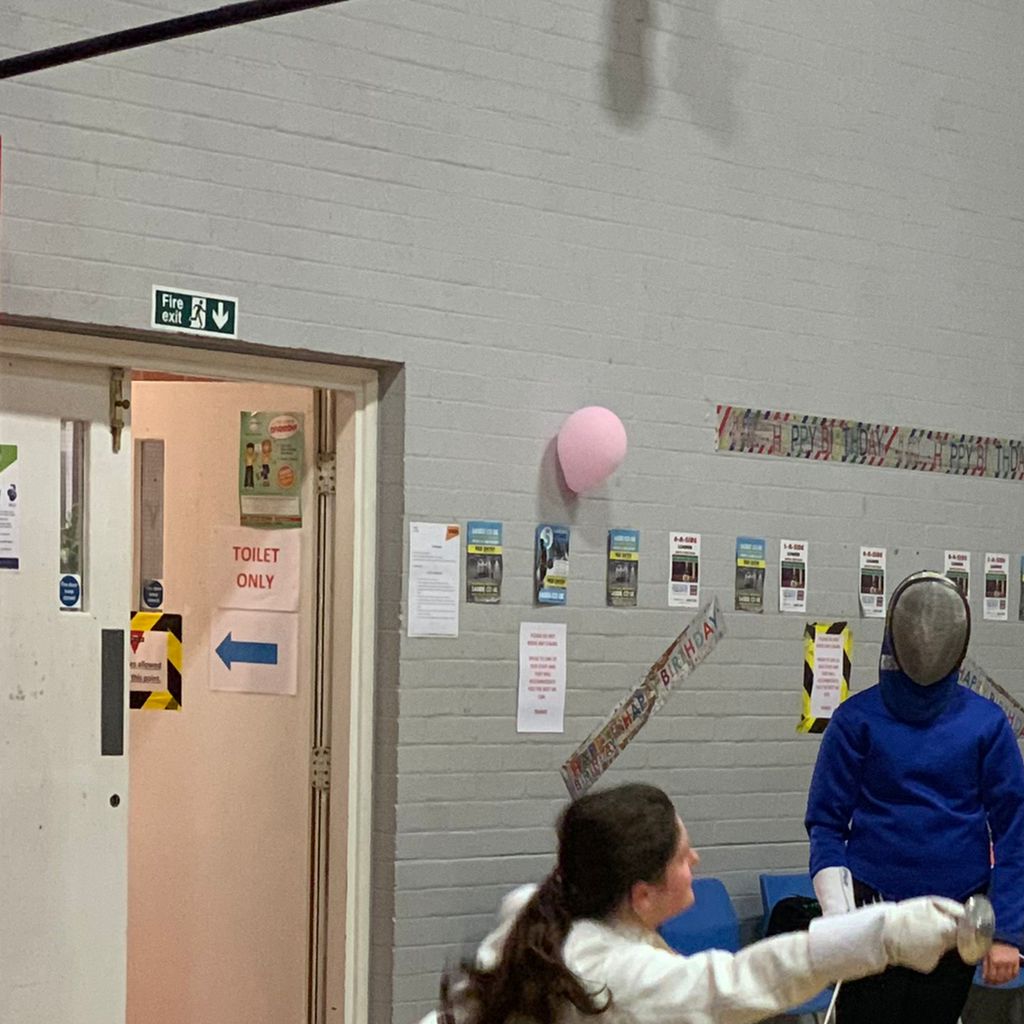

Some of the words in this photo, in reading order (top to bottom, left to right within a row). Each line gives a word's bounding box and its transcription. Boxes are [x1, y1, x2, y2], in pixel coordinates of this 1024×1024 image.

[162, 293, 184, 310] Fire
[162, 310, 182, 324] exit
[773, 424, 818, 453] HPPY
[821, 426, 885, 457] BITHDAY
[934, 438, 974, 470] HPPY
[232, 546, 280, 563] TOILET
[236, 572, 274, 590] ONLY
